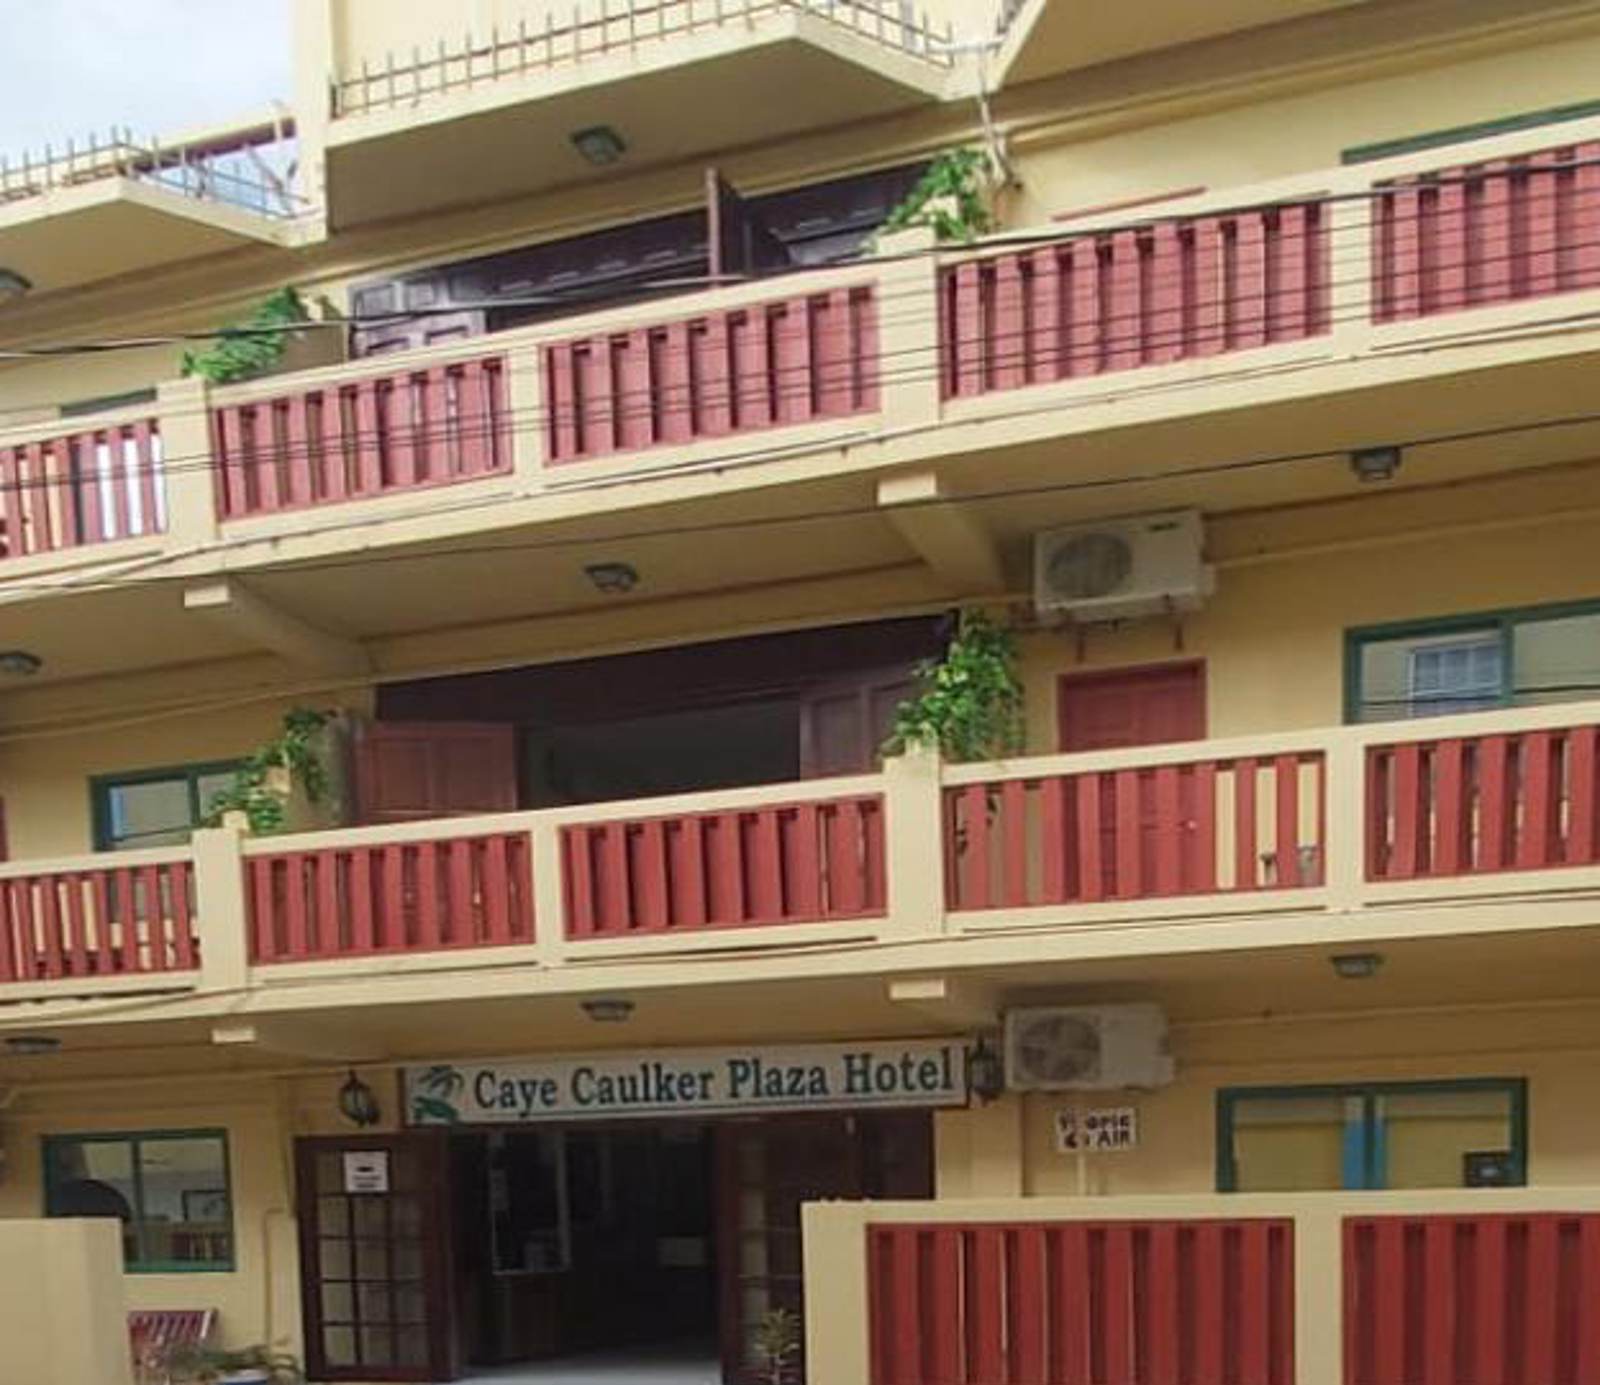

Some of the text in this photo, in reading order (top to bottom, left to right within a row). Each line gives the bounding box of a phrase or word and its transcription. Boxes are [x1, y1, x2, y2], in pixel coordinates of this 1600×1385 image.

[475, 1047, 953, 1117] Caye Caulker Plaza Hotel
[1098, 1130, 1130, 1147] AIR
